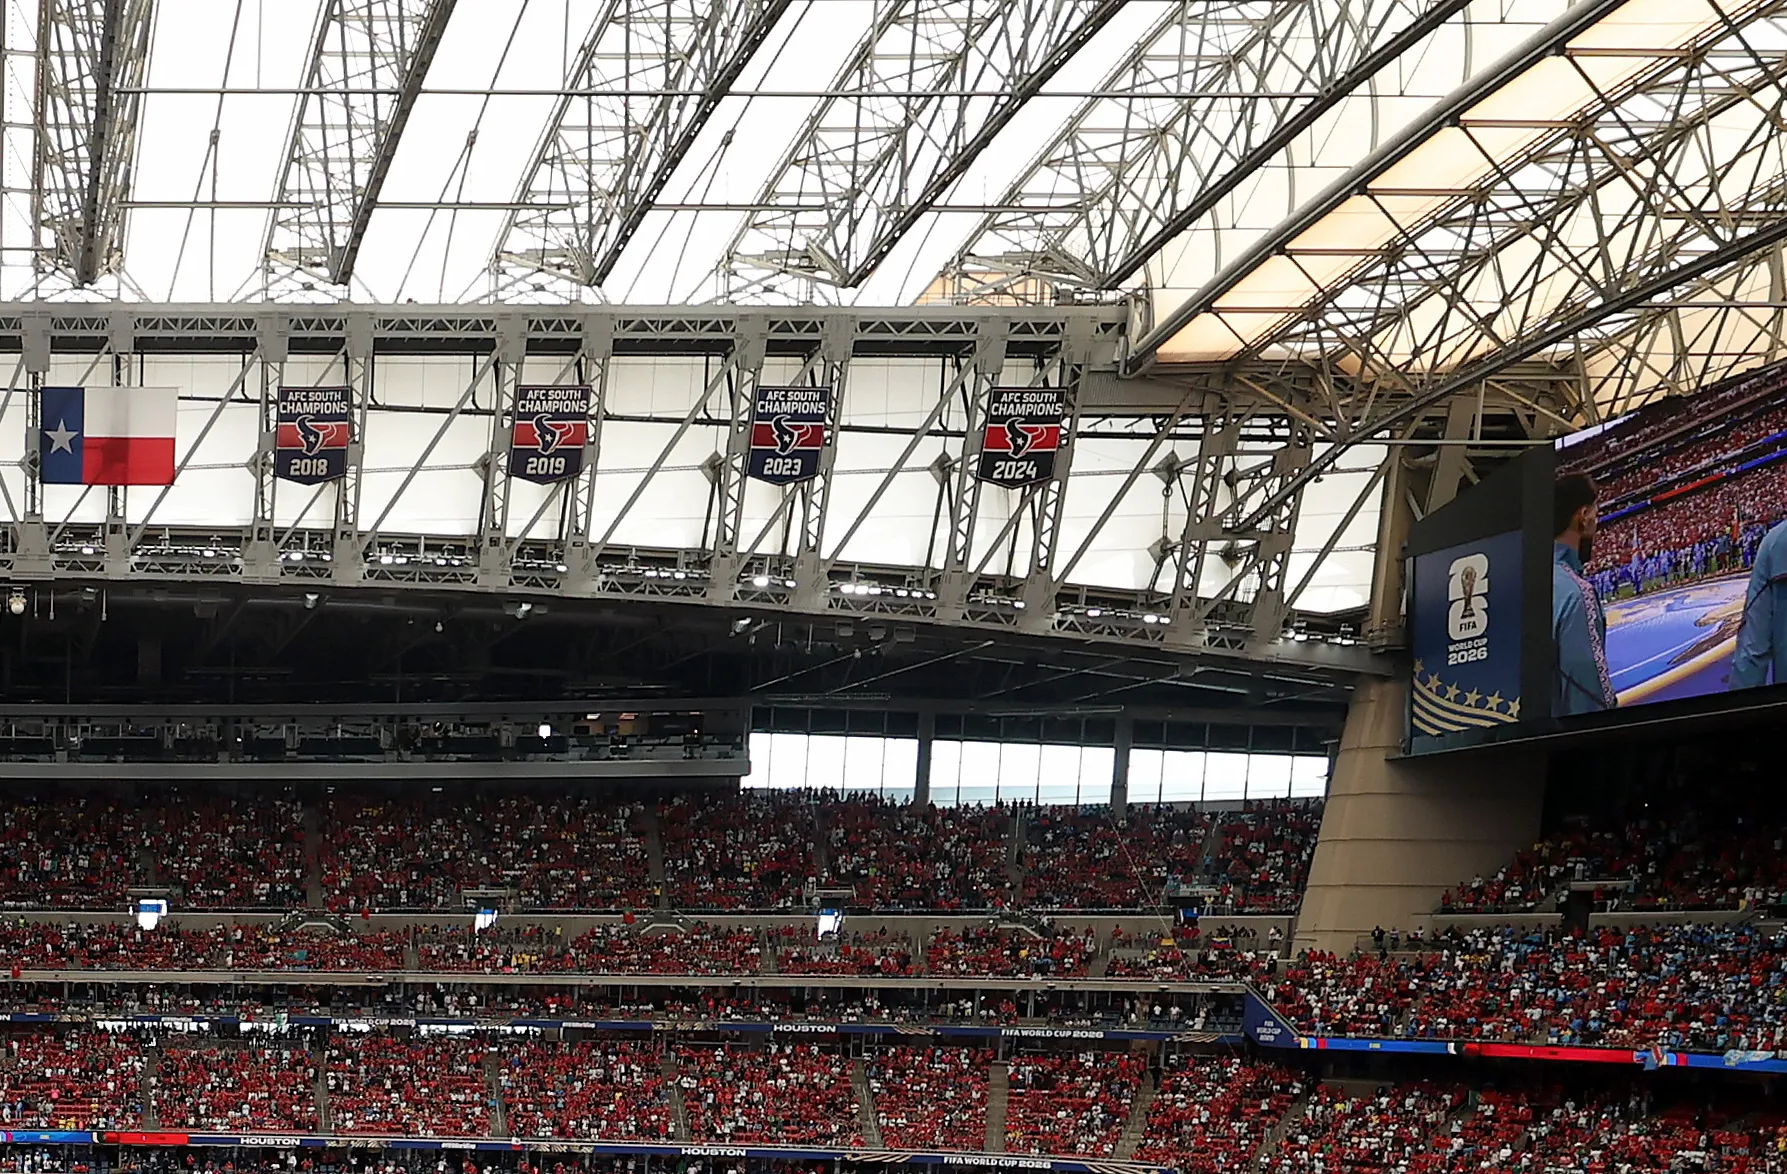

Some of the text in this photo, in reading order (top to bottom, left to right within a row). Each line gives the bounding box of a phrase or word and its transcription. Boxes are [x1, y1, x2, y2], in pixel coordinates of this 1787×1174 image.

[288, 391, 341, 401] AFC SOUTH
[527, 390, 581, 400] AFC SOUTH
[767, 392, 820, 401] AFC SOUTH
[1000, 392, 1056, 403] AFC SOUTH
[280, 401, 347, 414] CHAMPIONS
[518, 400, 587, 413] CHAMPIONS
[757, 401, 826, 414] CHAMPIONS
[991, 403, 1062, 416] CHAMPIONS
[290, 459, 327, 475] 2018
[526, 458, 565, 474] 2019
[763, 458, 801, 475] 2023
[993, 461, 1037, 479] 2024
[1460, 621, 1476, 632] FIFA
[1448, 638, 1487, 653] WORLD CUP
[1448, 647, 1487, 665] 2026
[774, 1024, 836, 1032] HOUSTON
[682, 1148, 746, 1156] HOUSTON
[944, 1156, 963, 1164] FIFA
[964, 1157, 997, 1166] WORLD
[998, 1159, 1017, 1167] CUP
